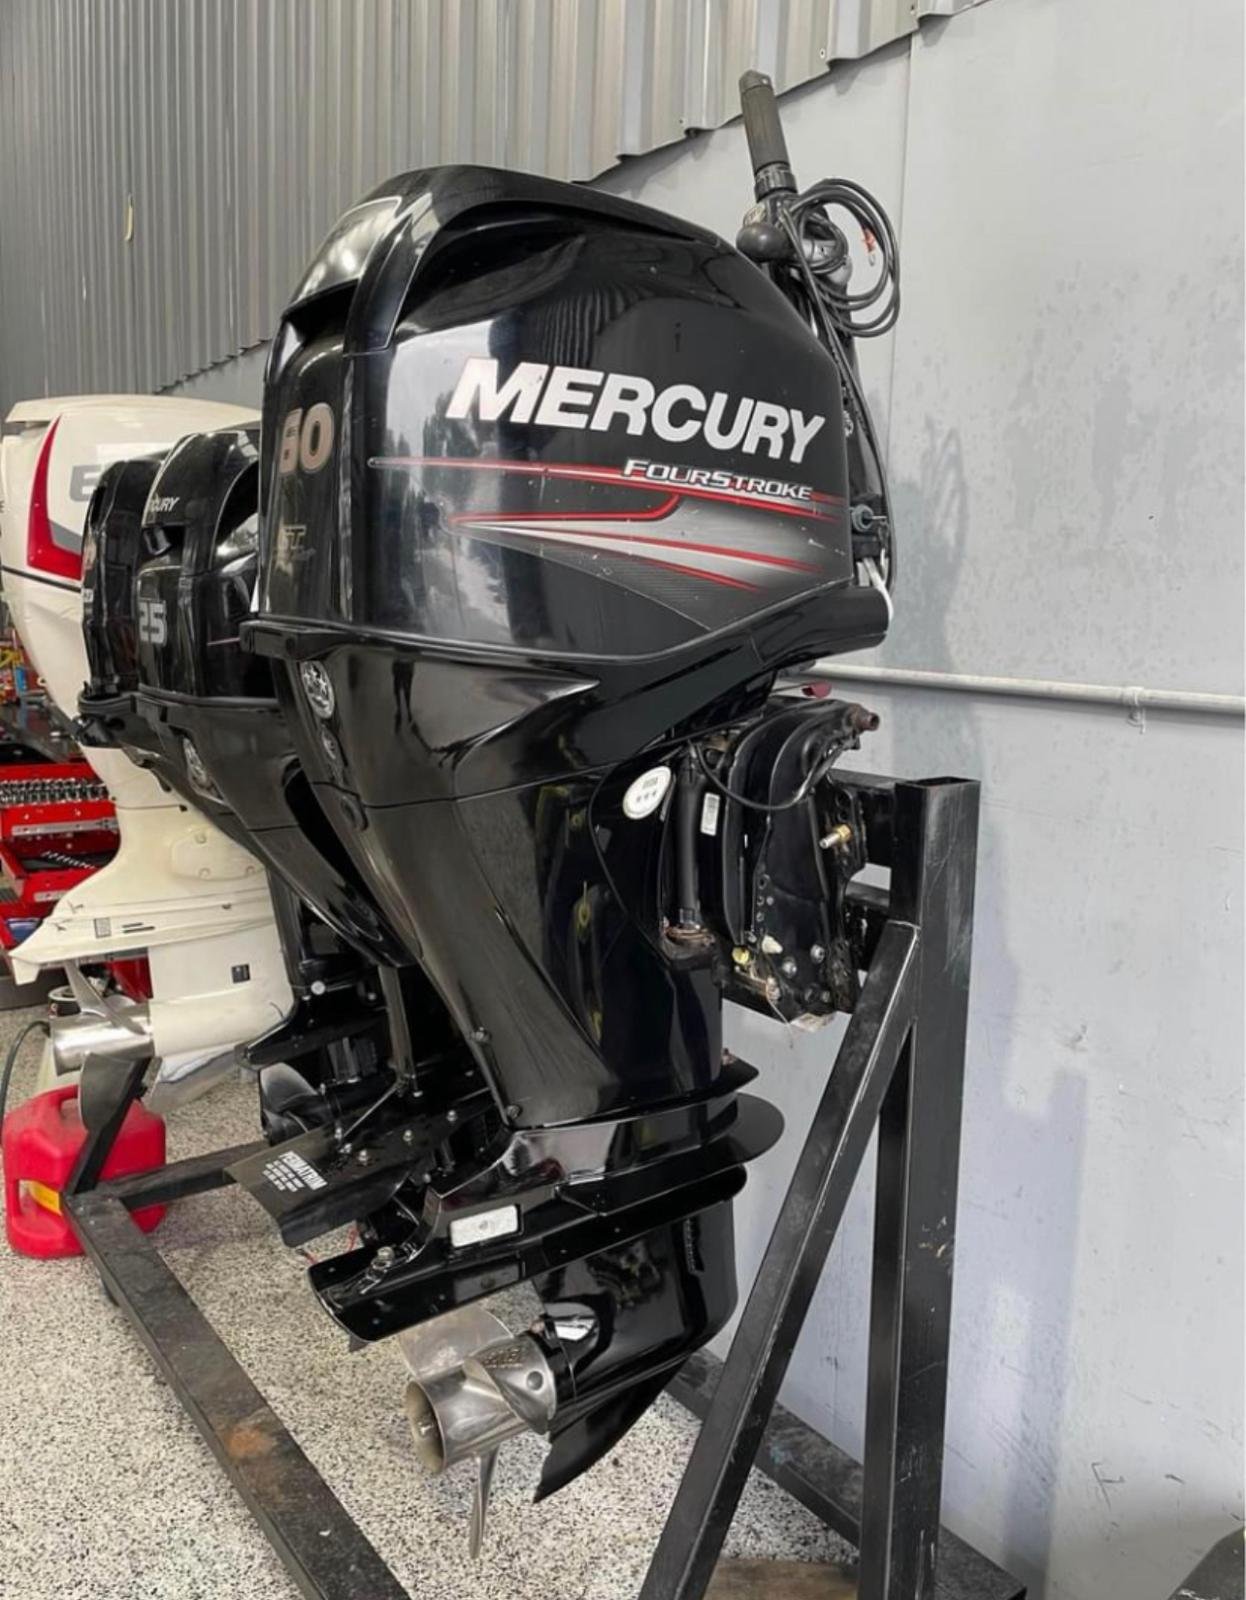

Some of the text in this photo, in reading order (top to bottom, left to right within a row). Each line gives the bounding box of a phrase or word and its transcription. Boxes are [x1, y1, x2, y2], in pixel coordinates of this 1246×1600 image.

[279, 402, 335, 474] 60
[445, 357, 826, 464] MERCURY
[622, 457, 813, 502] FOURSTROKE
[138, 600, 167, 647] 25
